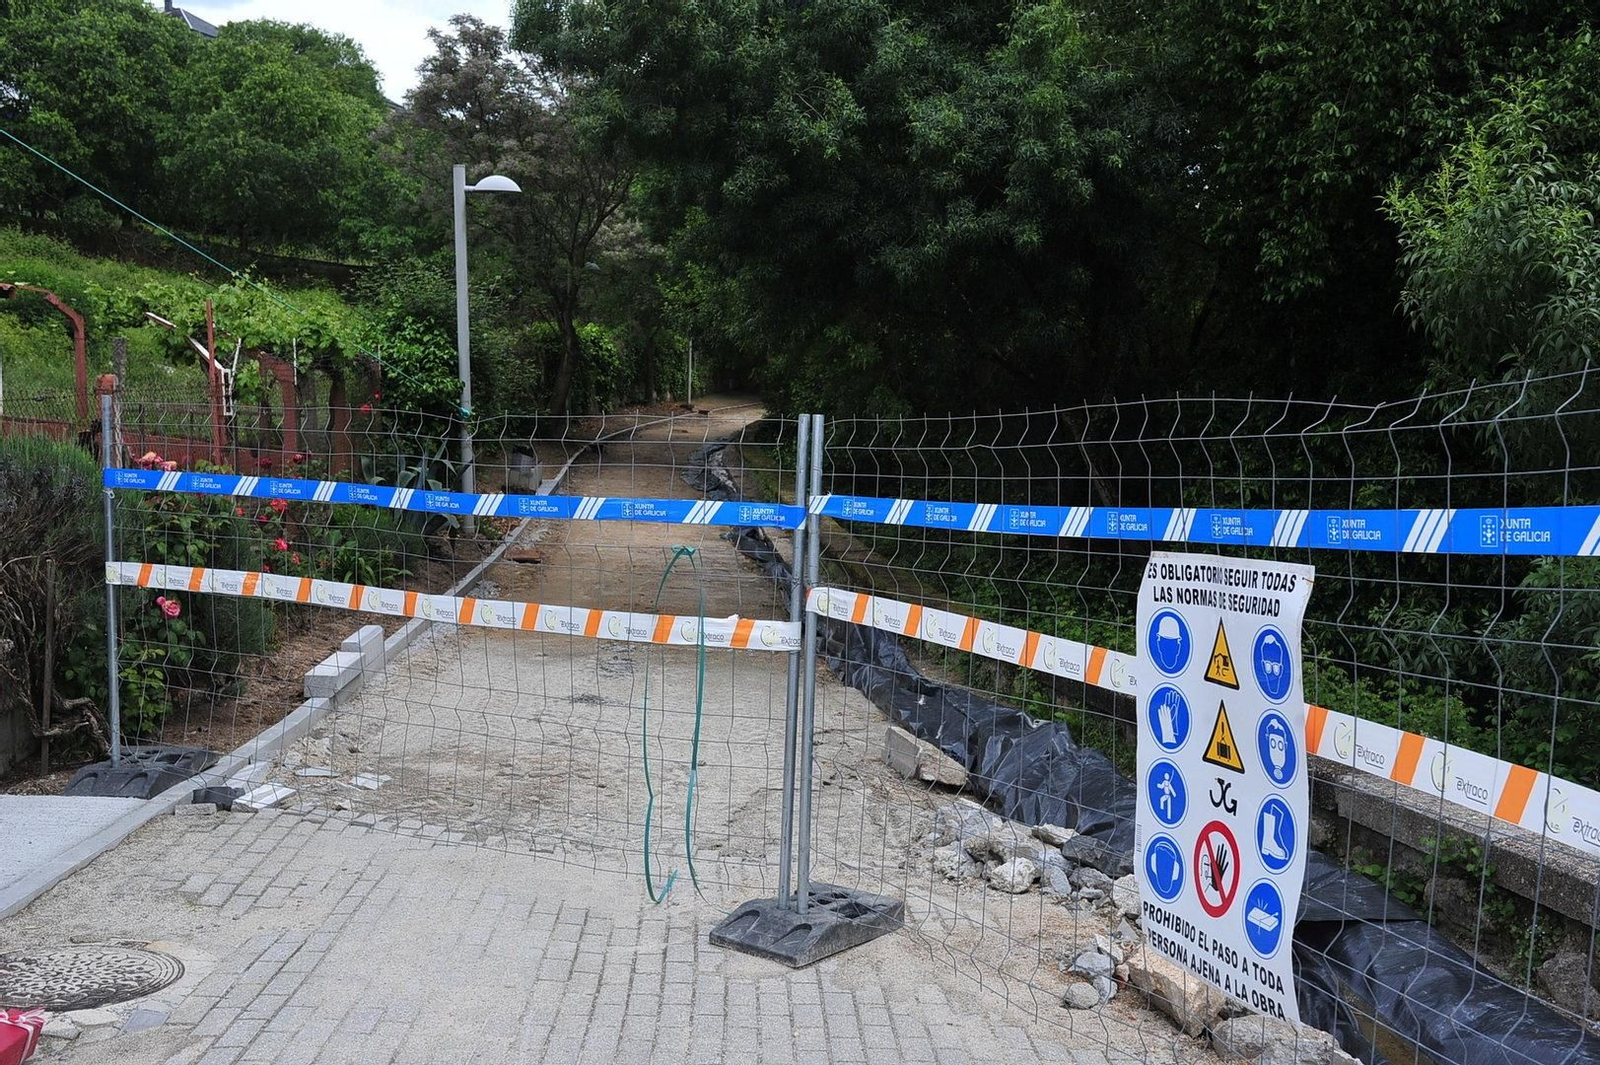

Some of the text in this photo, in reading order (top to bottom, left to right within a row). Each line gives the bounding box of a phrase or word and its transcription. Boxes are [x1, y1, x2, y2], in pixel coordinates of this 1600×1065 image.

[1222, 517, 1241, 525] XUNTA
[1223, 526, 1230, 535] DE
[1352, 530, 1381, 540] GALICIA
[1513, 531, 1550, 542] GALICIA
[1148, 562, 1157, 579] ES
[1224, 568, 1258, 588] SEGUIR
[1262, 571, 1296, 593] TODAS
[1154, 586, 1280, 617] LAS NORMAS DE SEGURIDAD
[703, 632, 725, 642] xtraco
[1356, 744, 1385, 766] extraco
[1456, 777, 1488, 802] extraco
[1143, 901, 1285, 996] PROHIBIDO EL PASO A TODA
[1190, 954, 1221, 987] AJENA
[1224, 974, 1232, 993] A
[1235, 980, 1248, 1002] LA
[1251, 990, 1286, 1021] OBRA
